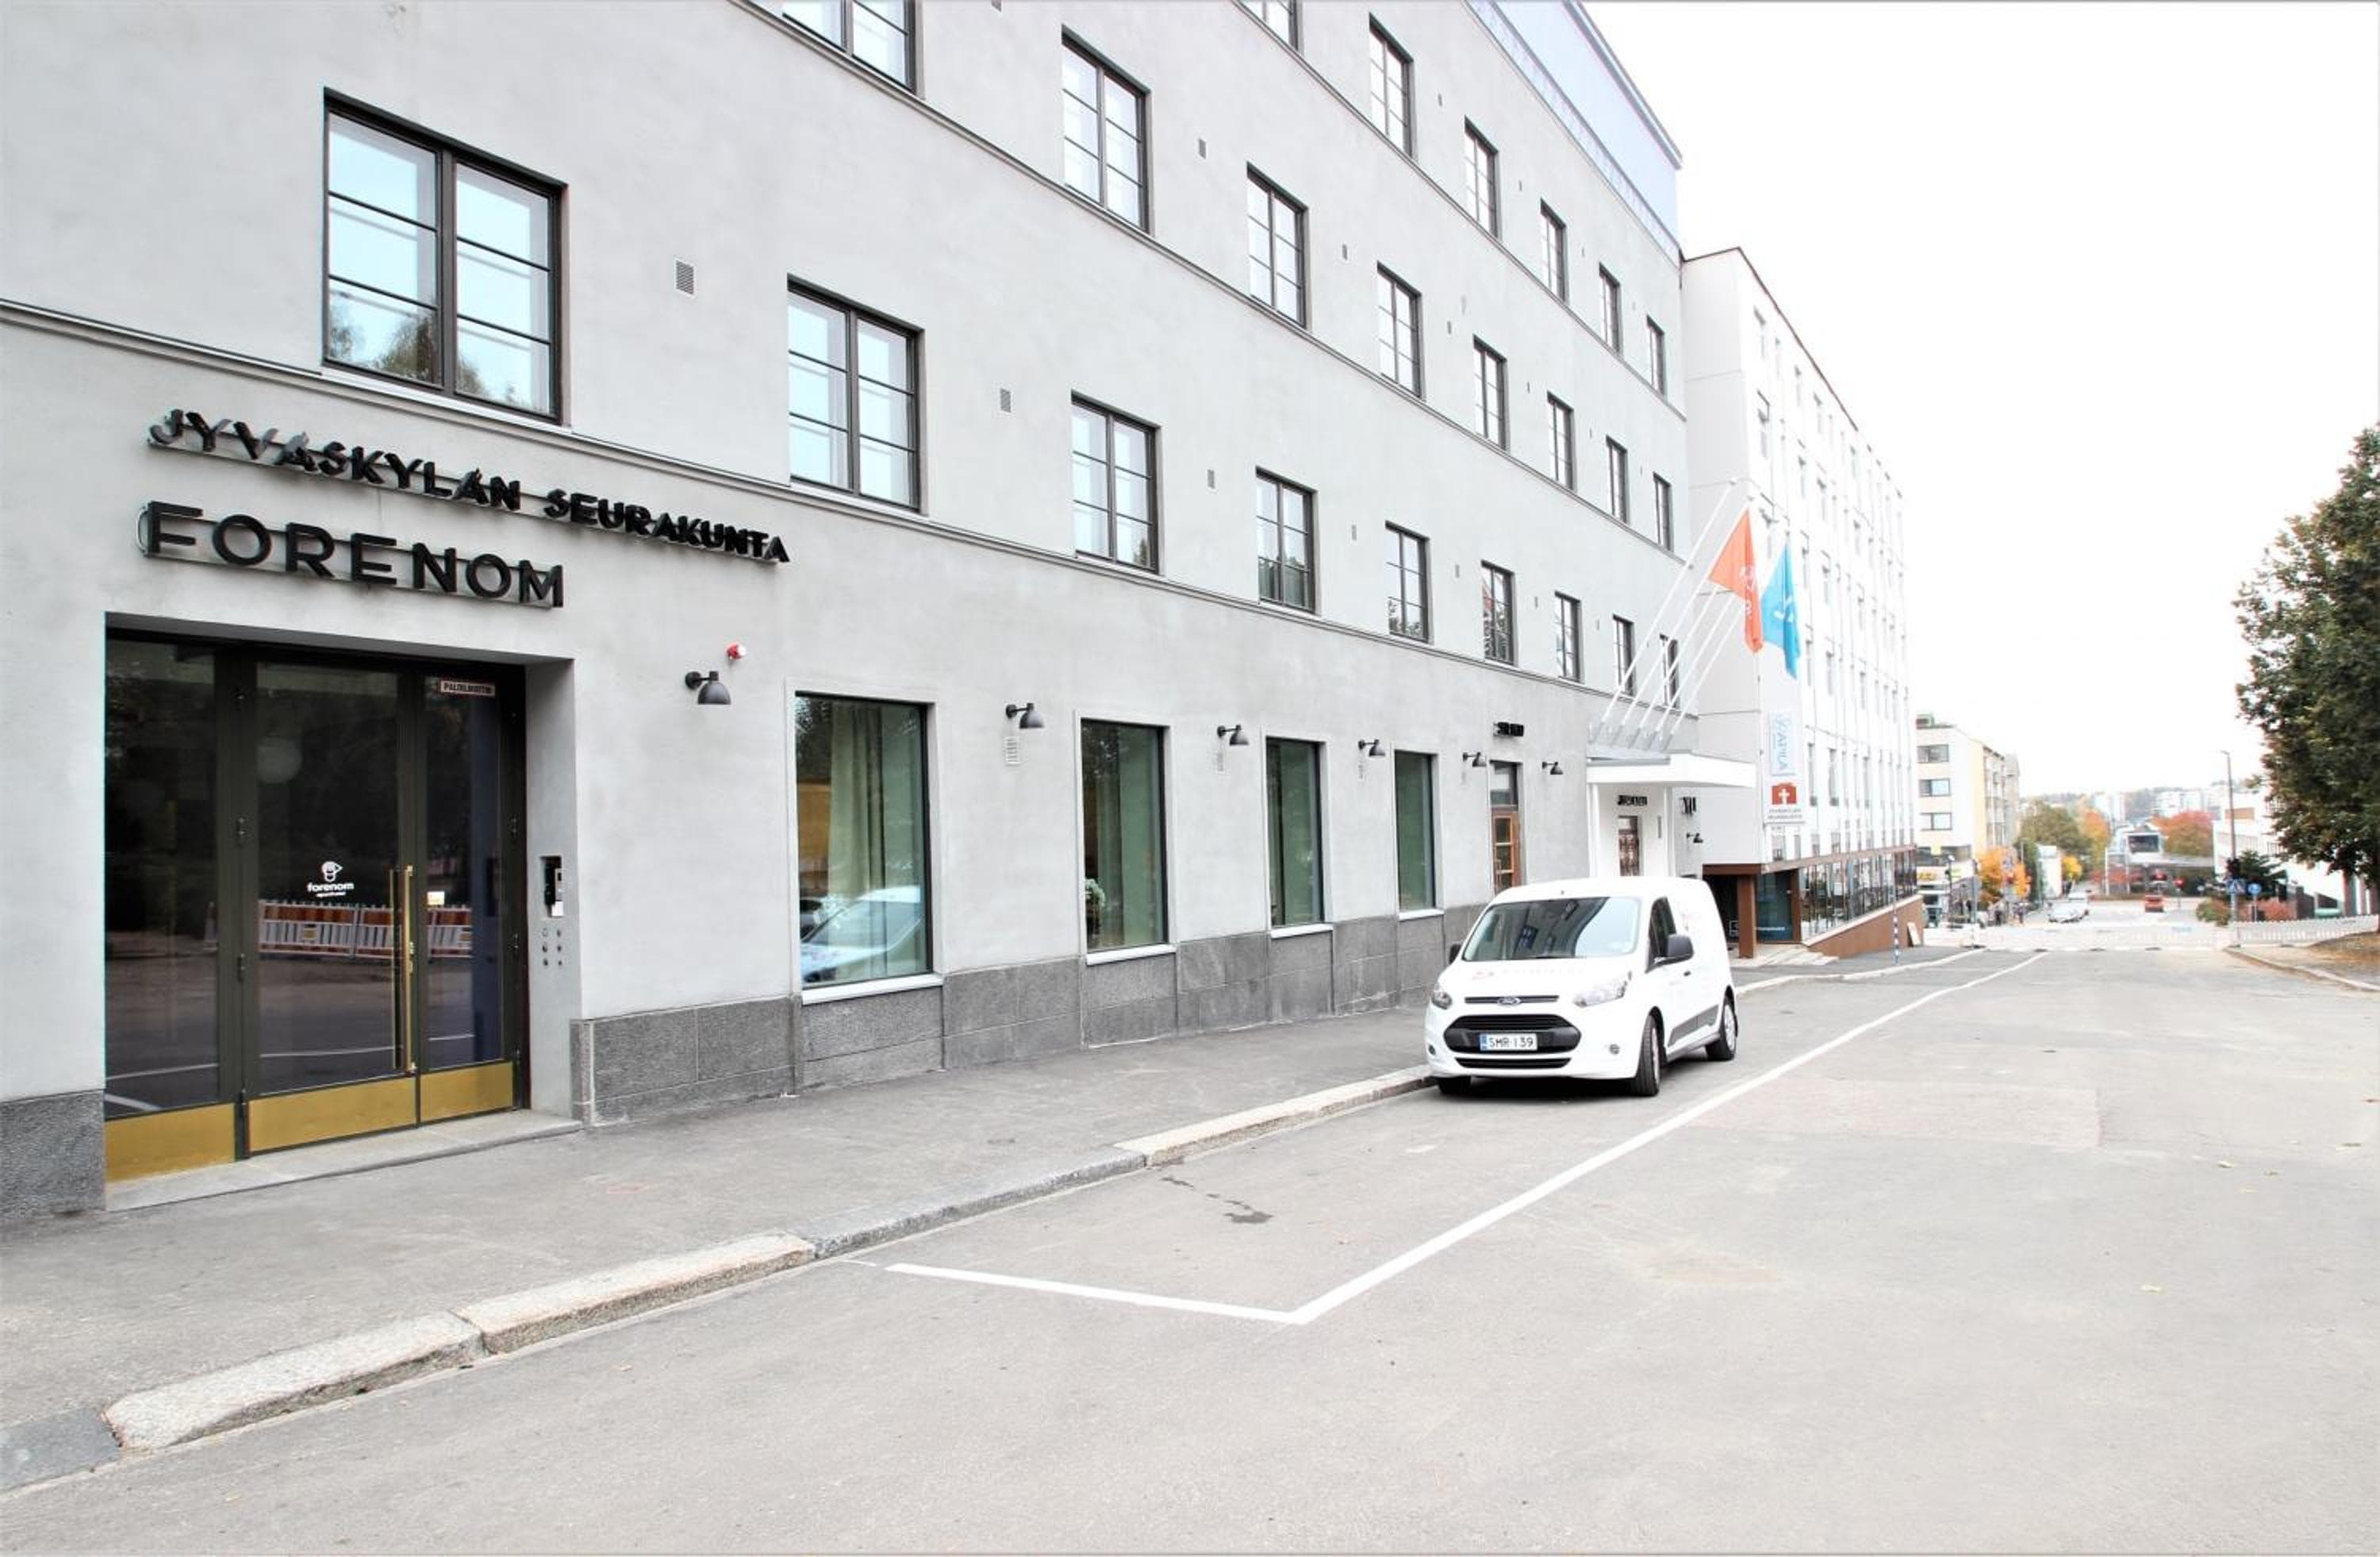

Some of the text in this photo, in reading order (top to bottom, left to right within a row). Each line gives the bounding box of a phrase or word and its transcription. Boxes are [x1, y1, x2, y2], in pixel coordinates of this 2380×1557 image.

[146, 500, 564, 608] FORENOM
[543, 489, 790, 562] SEURAKUNTA
[307, 882, 355, 892] forenom
